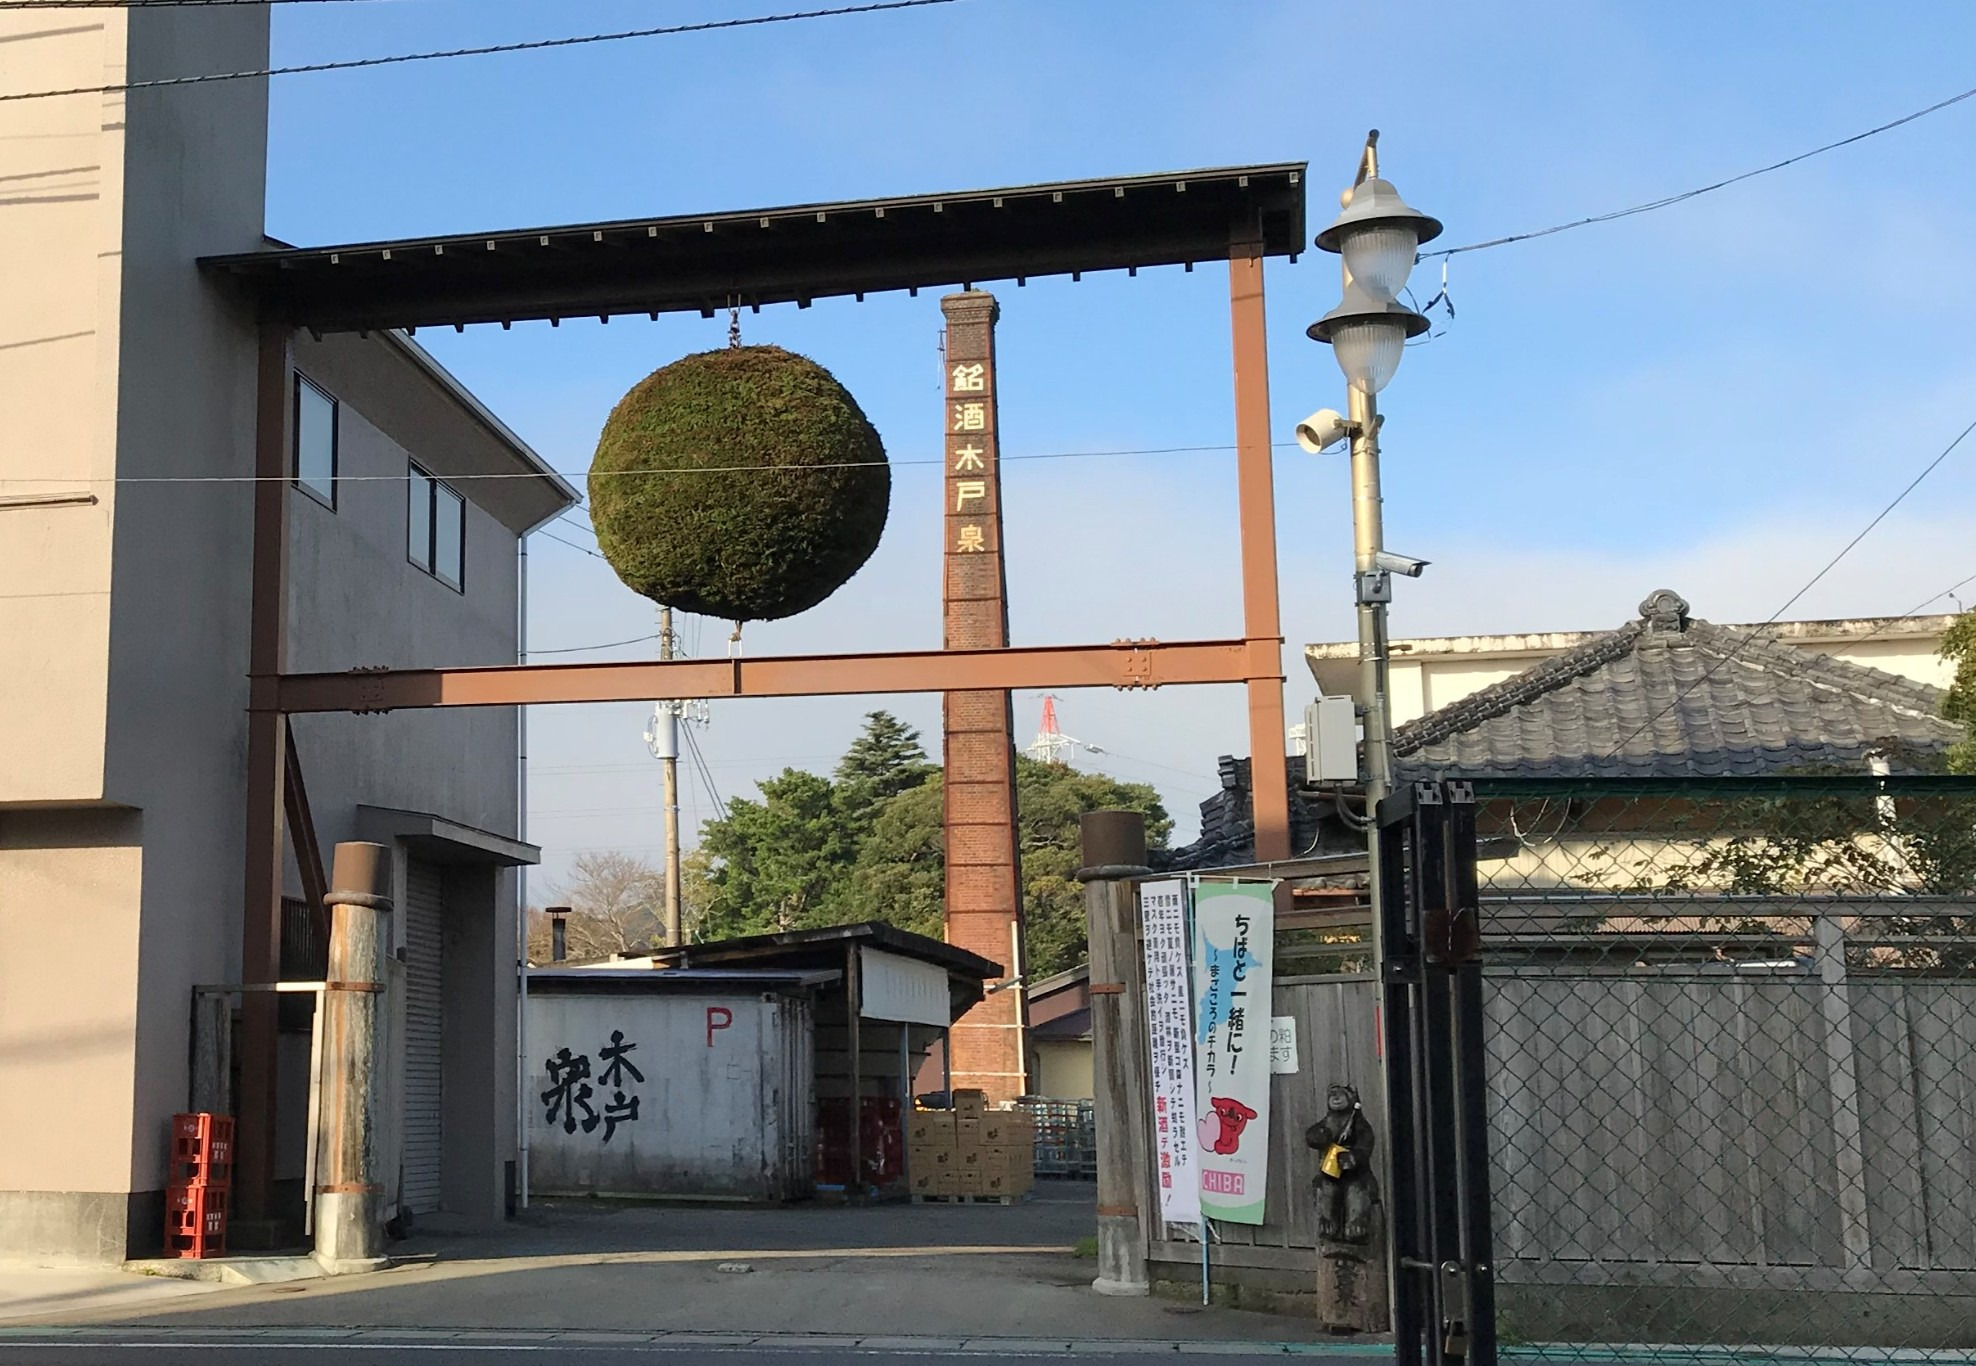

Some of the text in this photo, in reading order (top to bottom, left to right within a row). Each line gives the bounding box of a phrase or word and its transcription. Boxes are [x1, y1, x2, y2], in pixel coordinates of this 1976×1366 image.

[952, 363, 985, 553] 銘酒木戸泉
[707, 1007, 733, 1047] P
[1203, 1171, 1244, 1194] CHIBA
